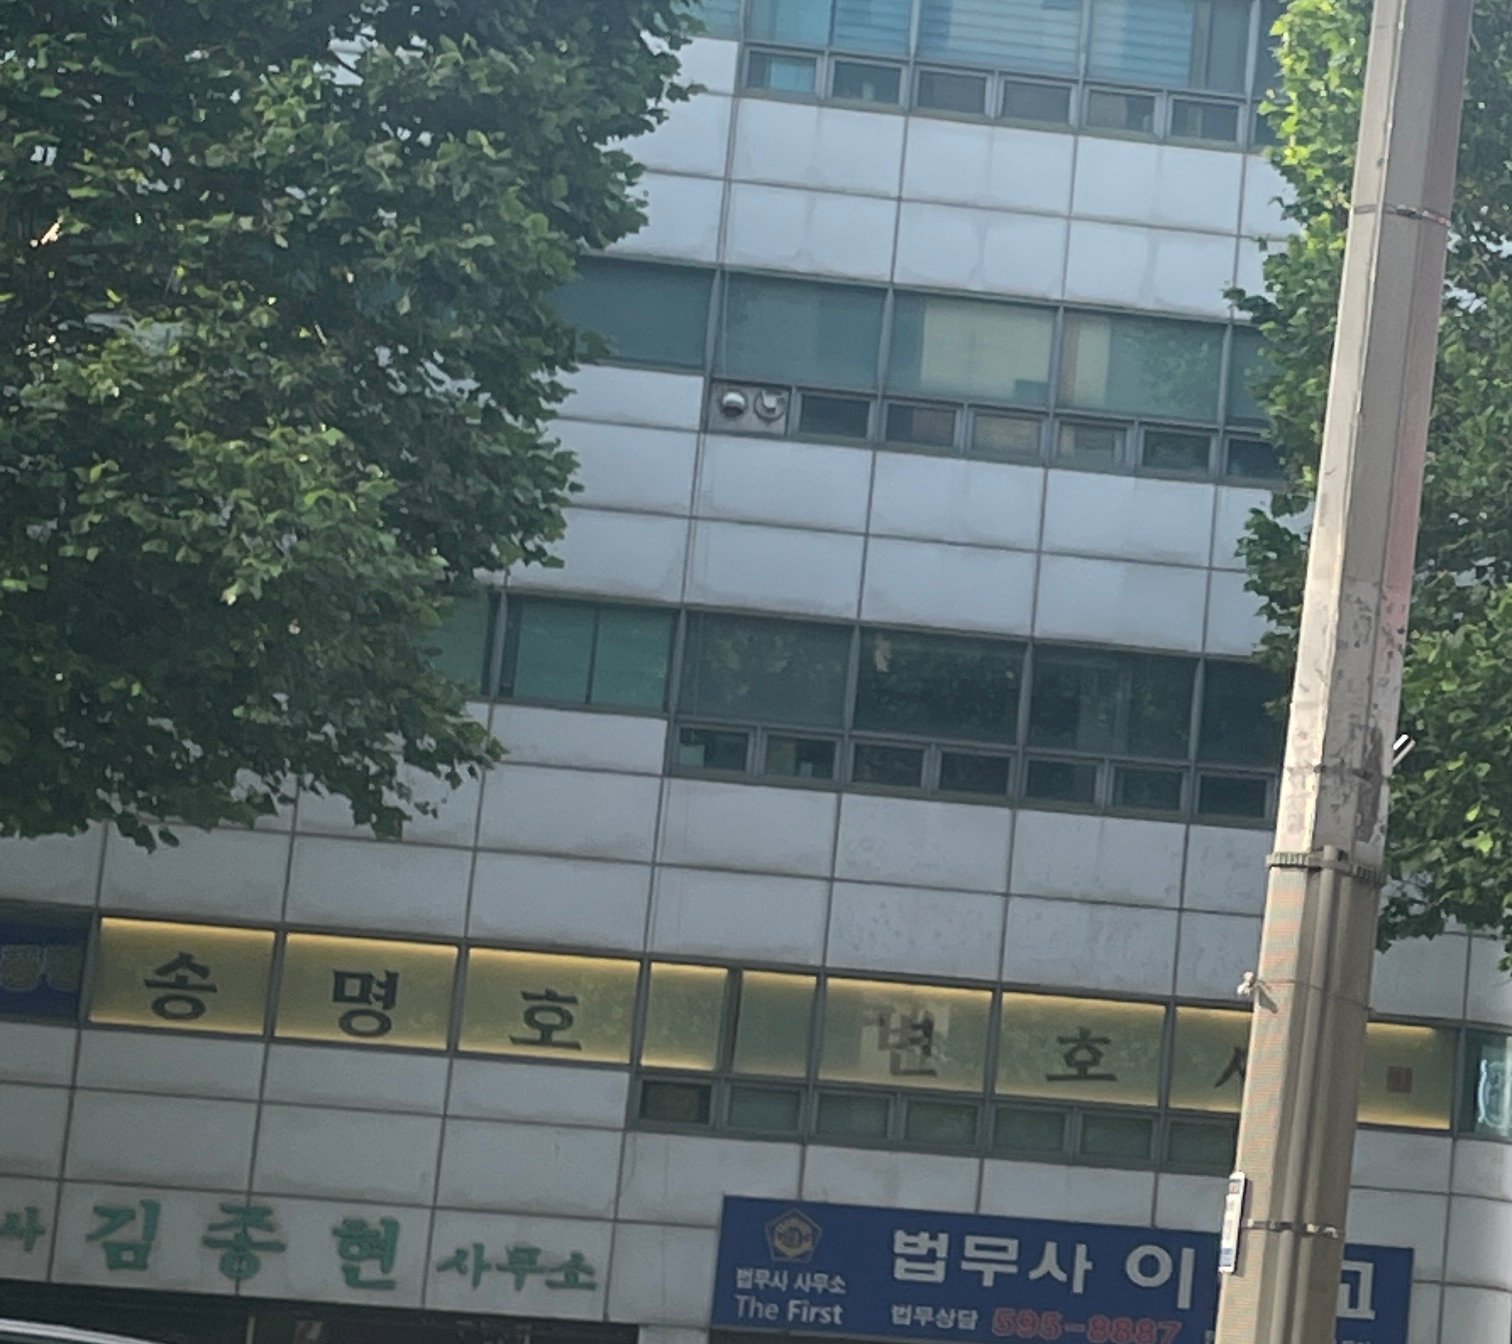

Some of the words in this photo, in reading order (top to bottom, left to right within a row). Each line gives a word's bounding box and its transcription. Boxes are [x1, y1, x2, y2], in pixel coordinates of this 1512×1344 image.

[143, 952, 582, 1050] 송명호
[86, 1199, 400, 1291] 김종현
[436, 1242, 597, 1292] 사무소
[892, 1229, 1093, 1294] 법무사
[735, 1267, 788, 1291] 법무사
[794, 1272, 847, 1295] 사무소
[734, 1294, 779, 1320] The
[787, 1299, 843, 1326] First
[891, 1304, 979, 1331] 법무상담
